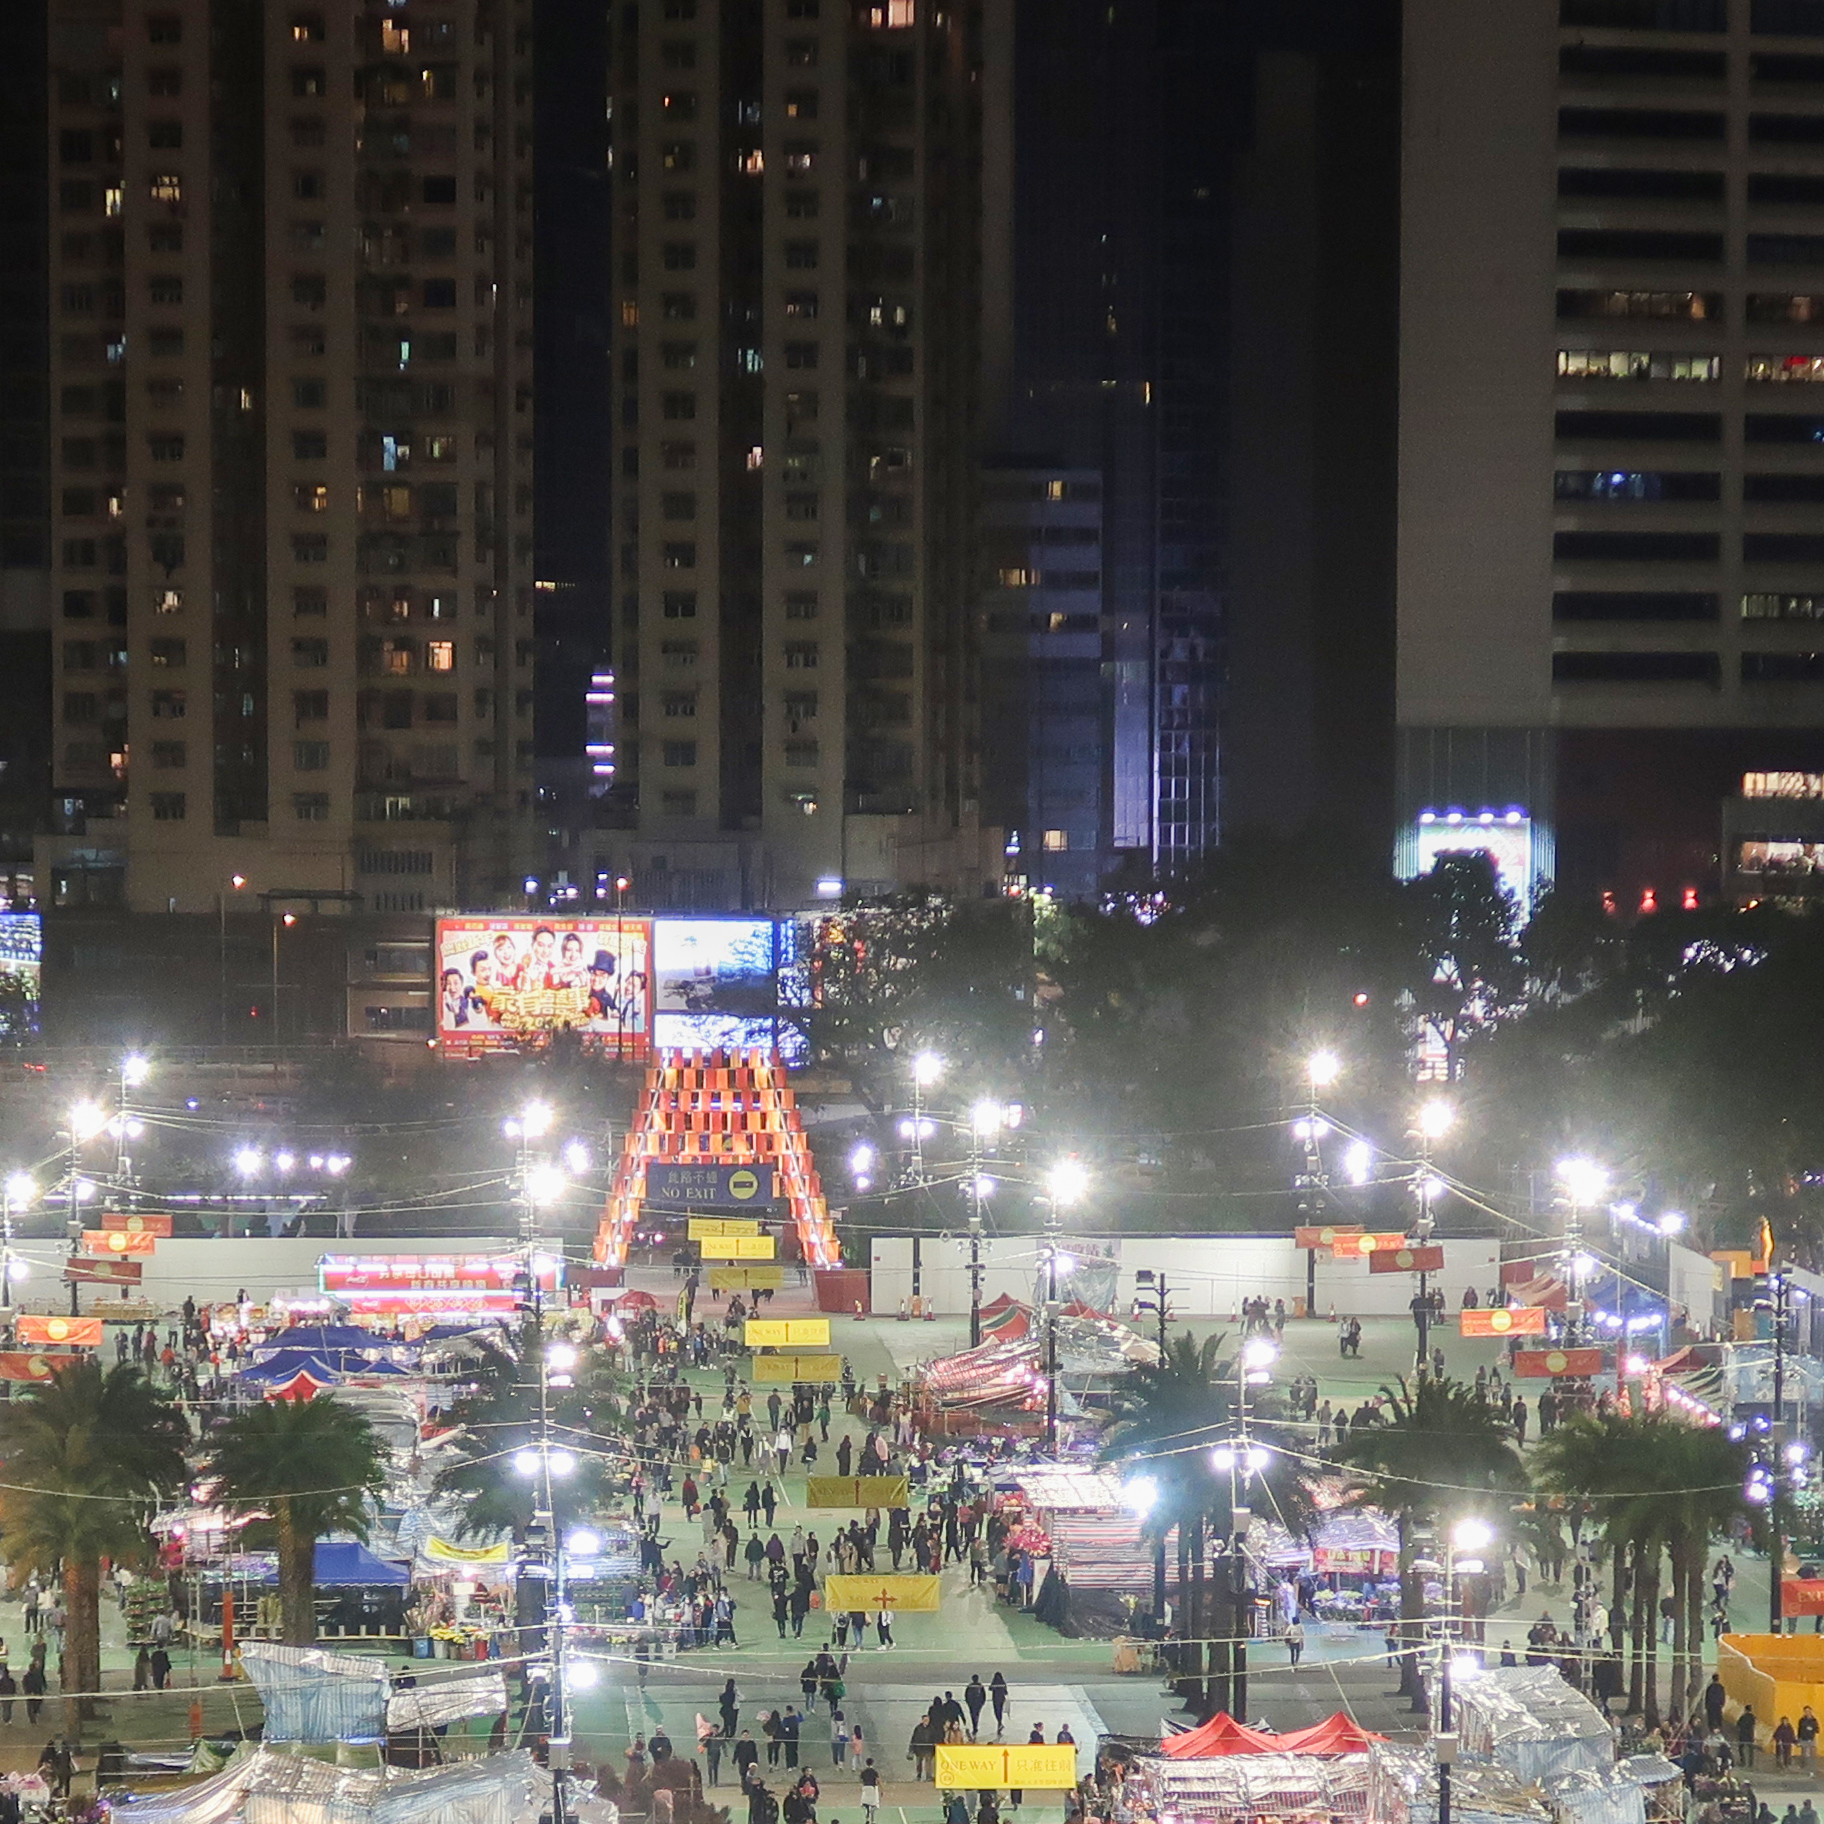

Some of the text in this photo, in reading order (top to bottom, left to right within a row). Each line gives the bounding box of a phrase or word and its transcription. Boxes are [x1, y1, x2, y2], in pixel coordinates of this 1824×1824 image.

[662, 1188, 717, 1198] NO EXIT
[941, 1761, 996, 1770] ONE WAY
